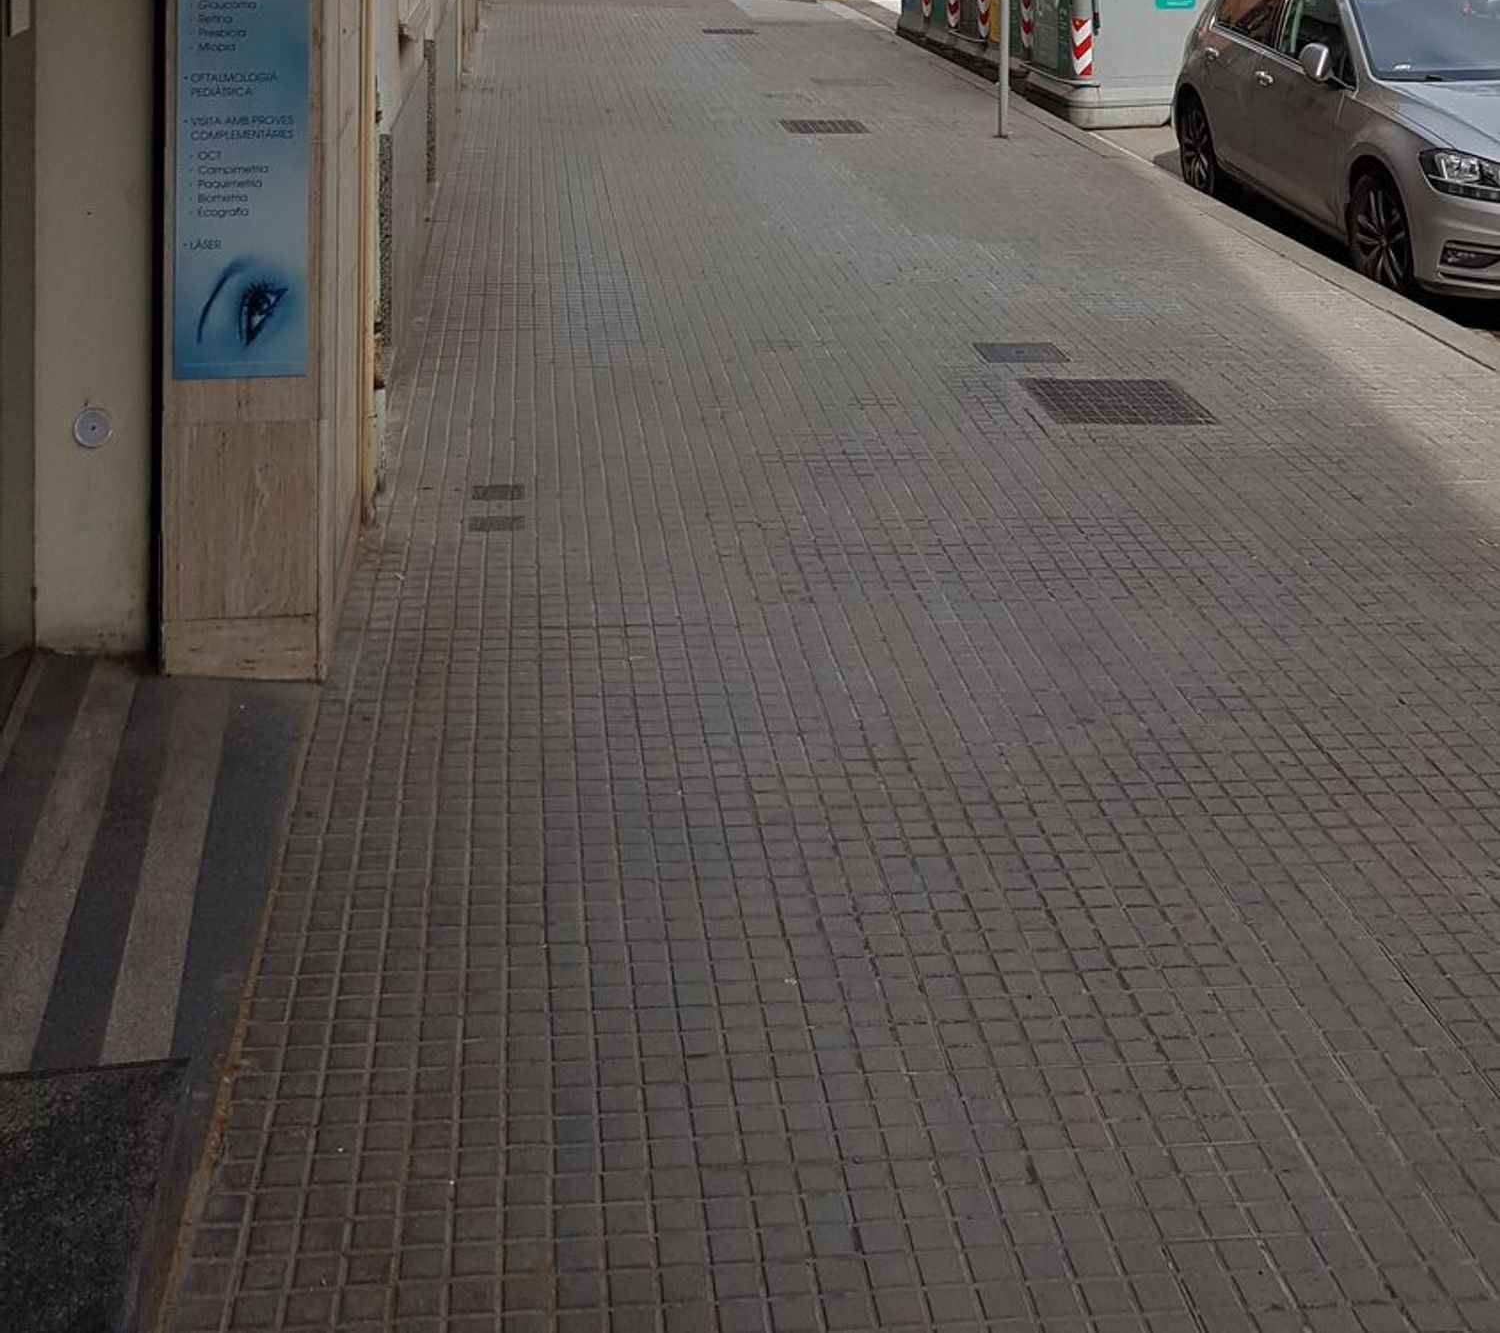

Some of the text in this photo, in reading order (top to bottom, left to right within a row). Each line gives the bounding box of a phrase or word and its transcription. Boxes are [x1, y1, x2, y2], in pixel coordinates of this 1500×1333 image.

[197, 0, 257, 10] Glaucoma
[197, 14, 233, 23] Retina
[197, 151, 222, 161] OCT
